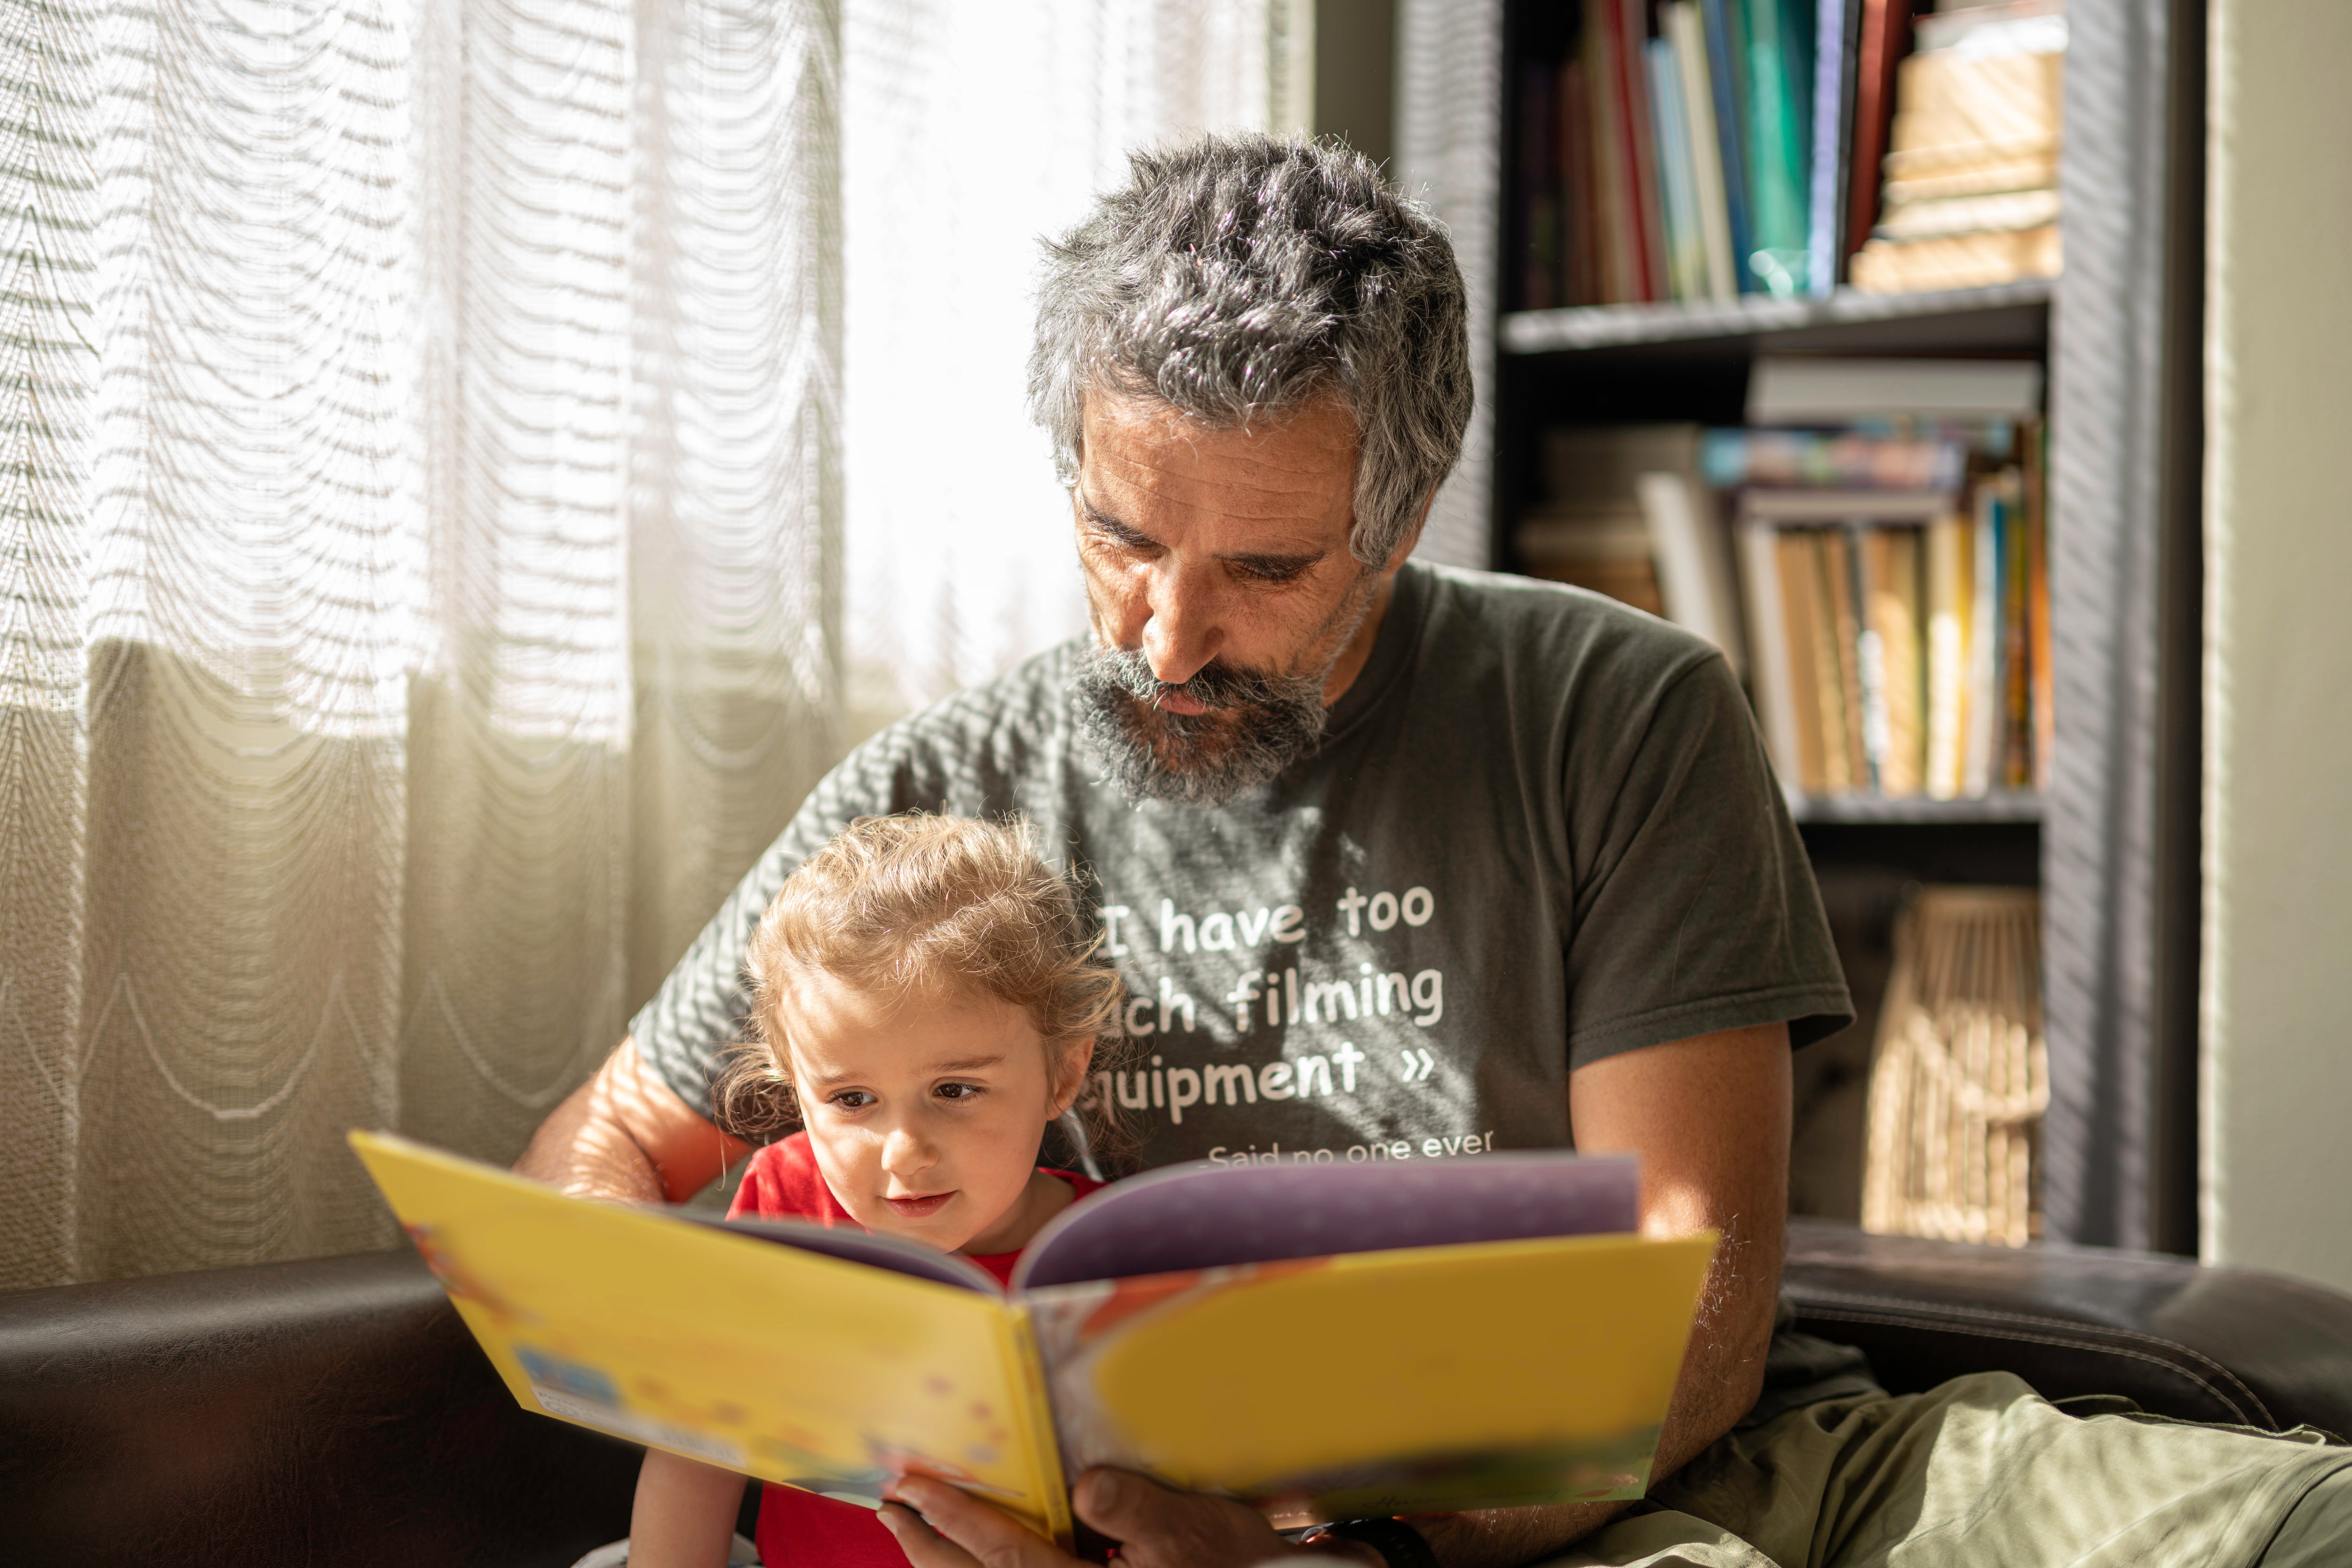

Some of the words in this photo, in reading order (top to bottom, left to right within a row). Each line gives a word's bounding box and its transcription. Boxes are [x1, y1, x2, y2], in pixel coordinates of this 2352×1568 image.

[1095, 905, 1130, 958] I
[1160, 898, 1306, 954] have
[1337, 886, 1435, 937] too
[1226, 962, 1444, 1028] filming
[1294, 1149, 1334, 1165] no
[1346, 1140, 1412, 1164] one
[1422, 1130, 1494, 1158] ever
